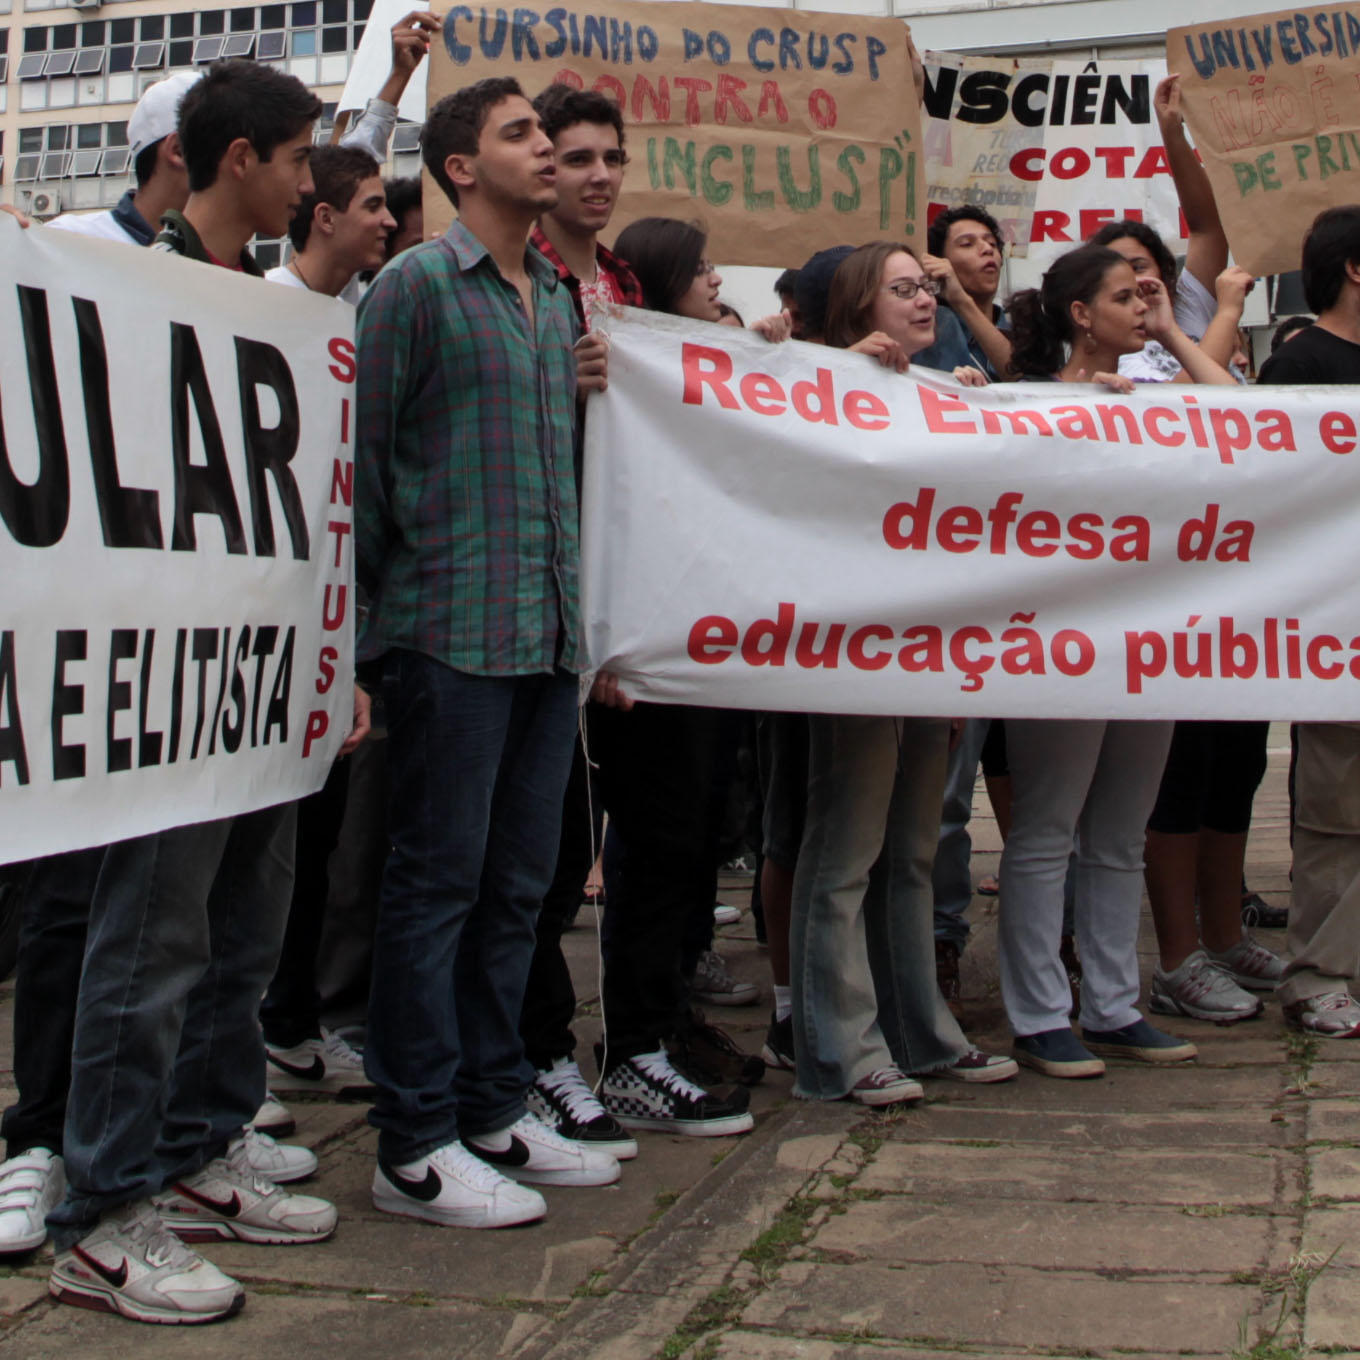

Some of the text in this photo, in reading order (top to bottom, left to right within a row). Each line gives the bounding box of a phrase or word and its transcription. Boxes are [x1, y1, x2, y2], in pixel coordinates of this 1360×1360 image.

[443, 5, 887, 81] CURSINHO DO CRUSP
[808, 88, 838, 129] O
[1210, 74, 1298, 152] NÃO
[1311, 64, 1339, 131] É
[1009, 146, 1204, 181] COTA
[1232, 150, 1282, 197] DE
[680, 342, 890, 432] Rede
[917, 386, 1298, 465] Emancipa
[881, 487, 1255, 563] defesa da
[686, 602, 1096, 692] educação
[52, 629, 87, 781] E
[107, 625, 297, 773] ELITISTA
